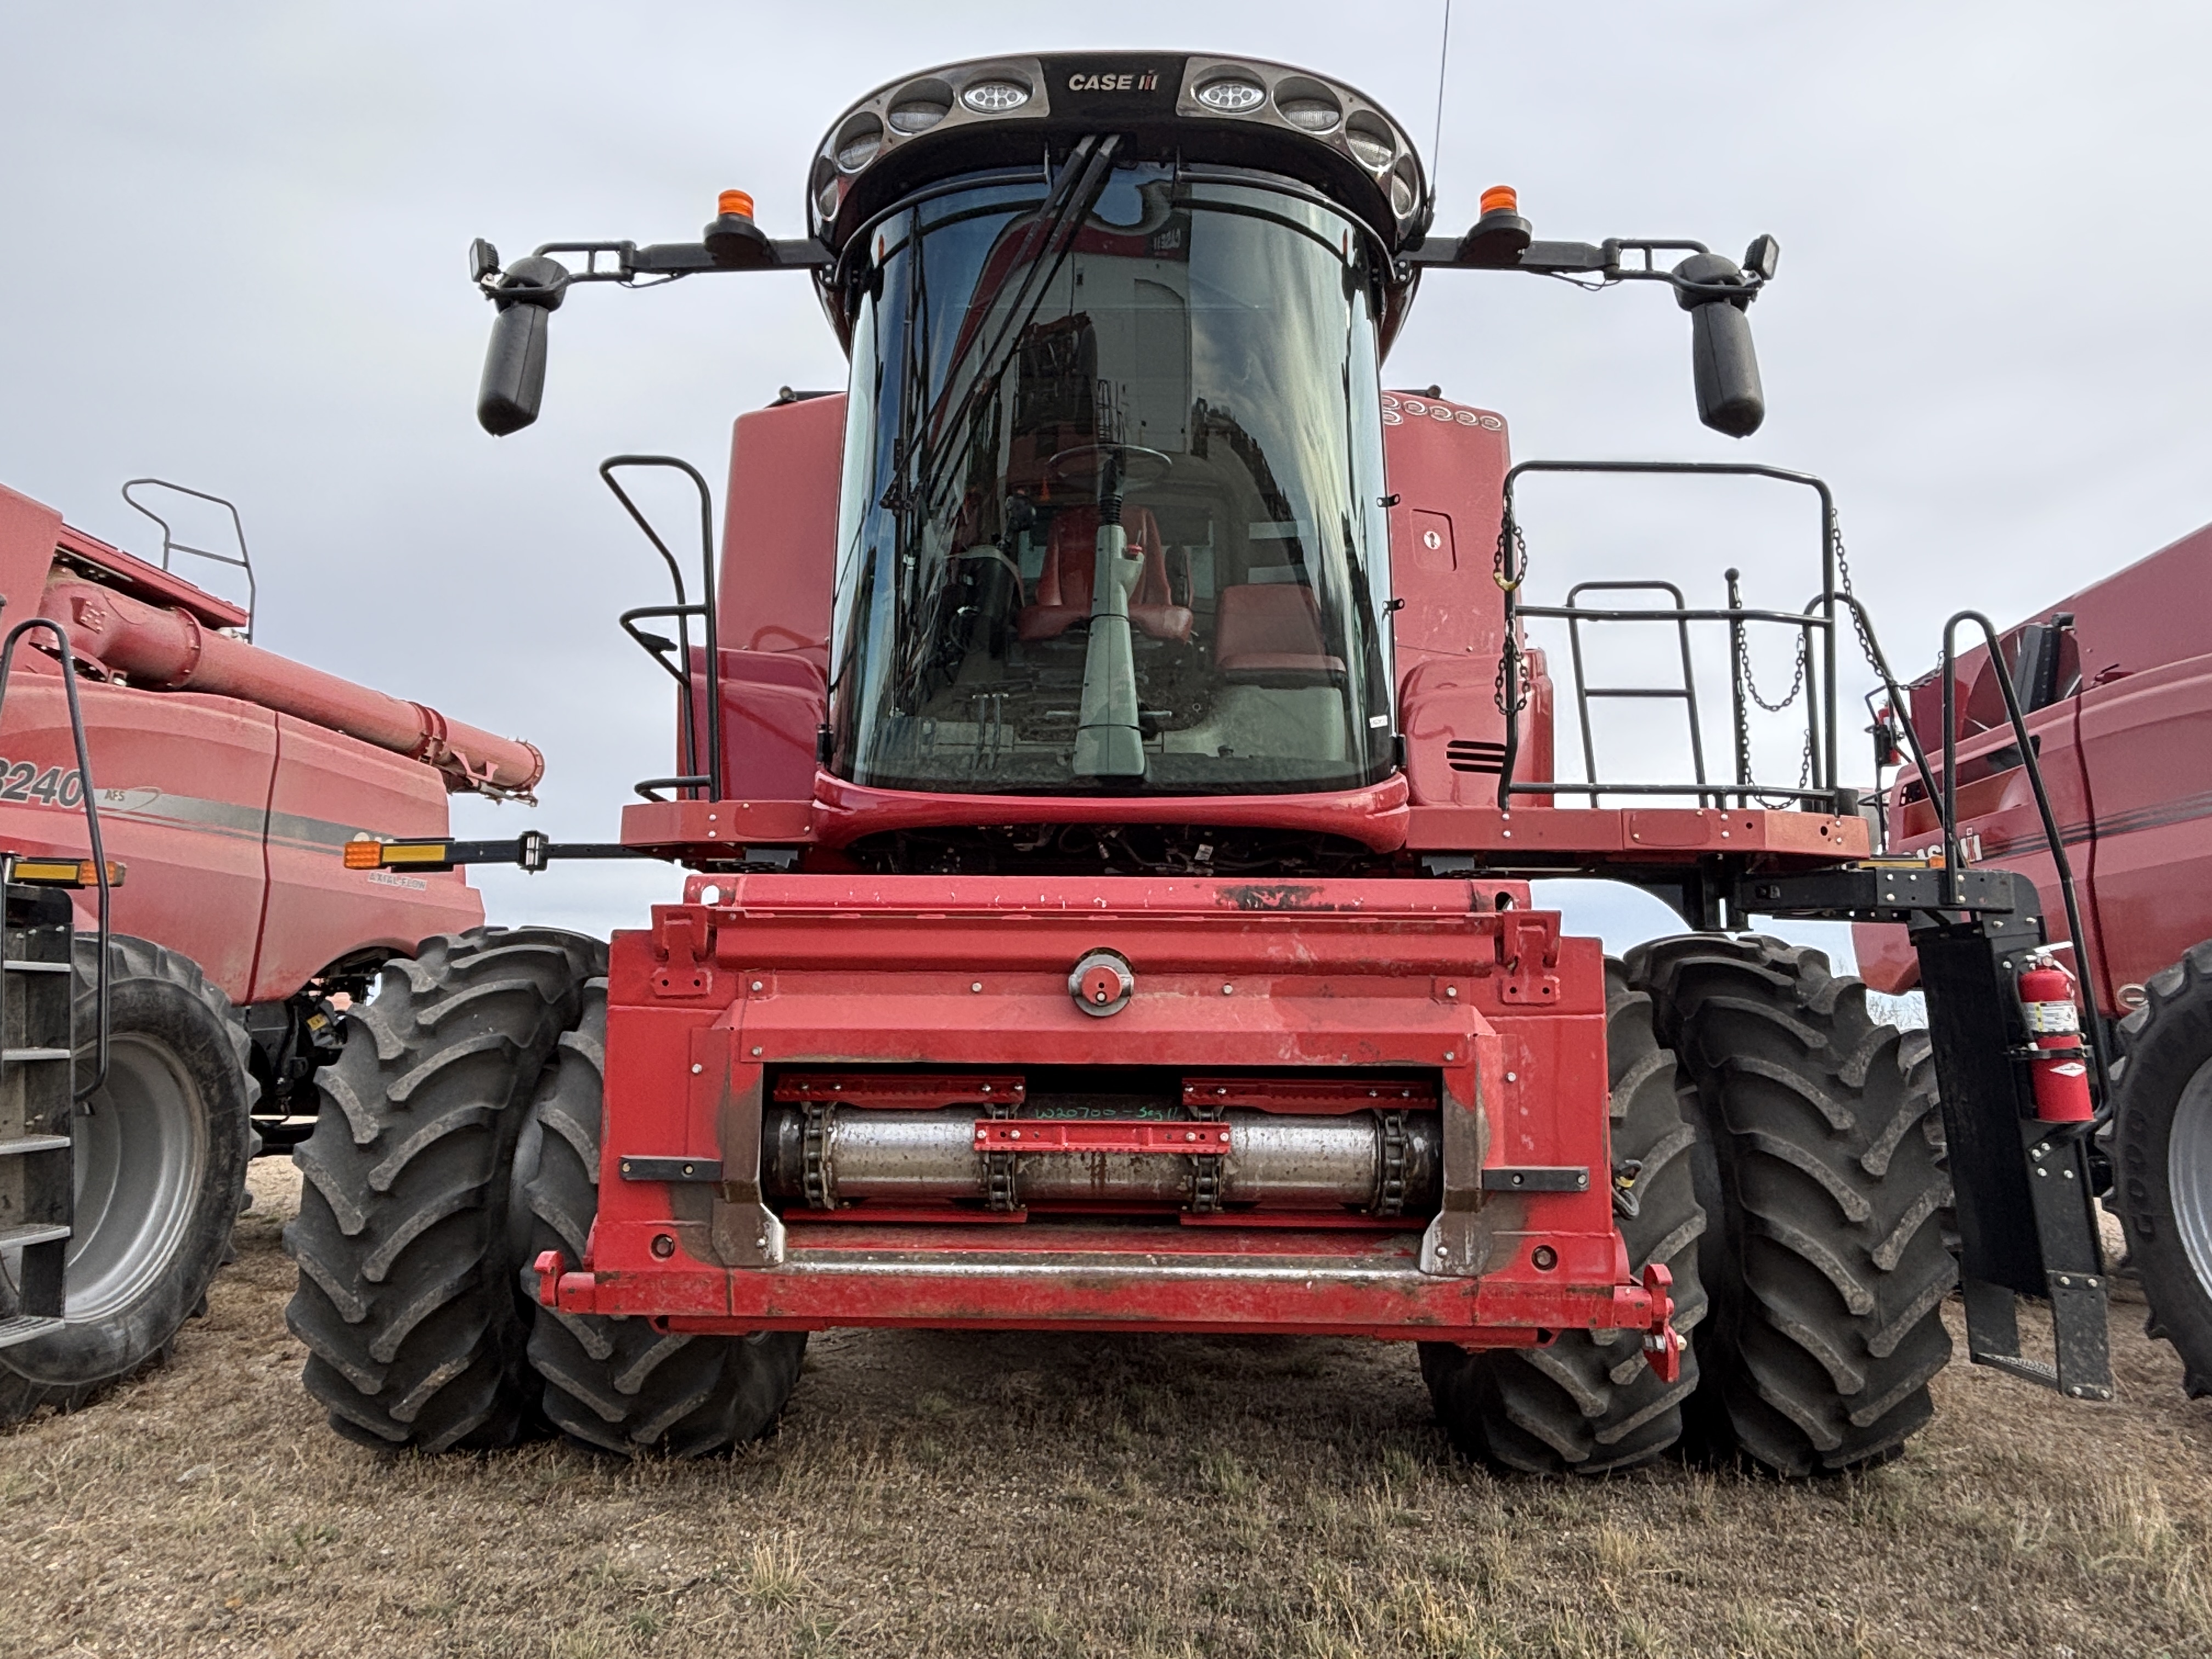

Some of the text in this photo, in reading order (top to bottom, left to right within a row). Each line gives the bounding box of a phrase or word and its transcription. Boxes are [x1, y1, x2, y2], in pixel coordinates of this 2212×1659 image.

[1069, 74, 1134, 91] CASE
[104, 789, 125, 802] AFS
[368, 871, 427, 890] AXIAL-FLOW
[1035, 1106, 1116, 1119] W20700
